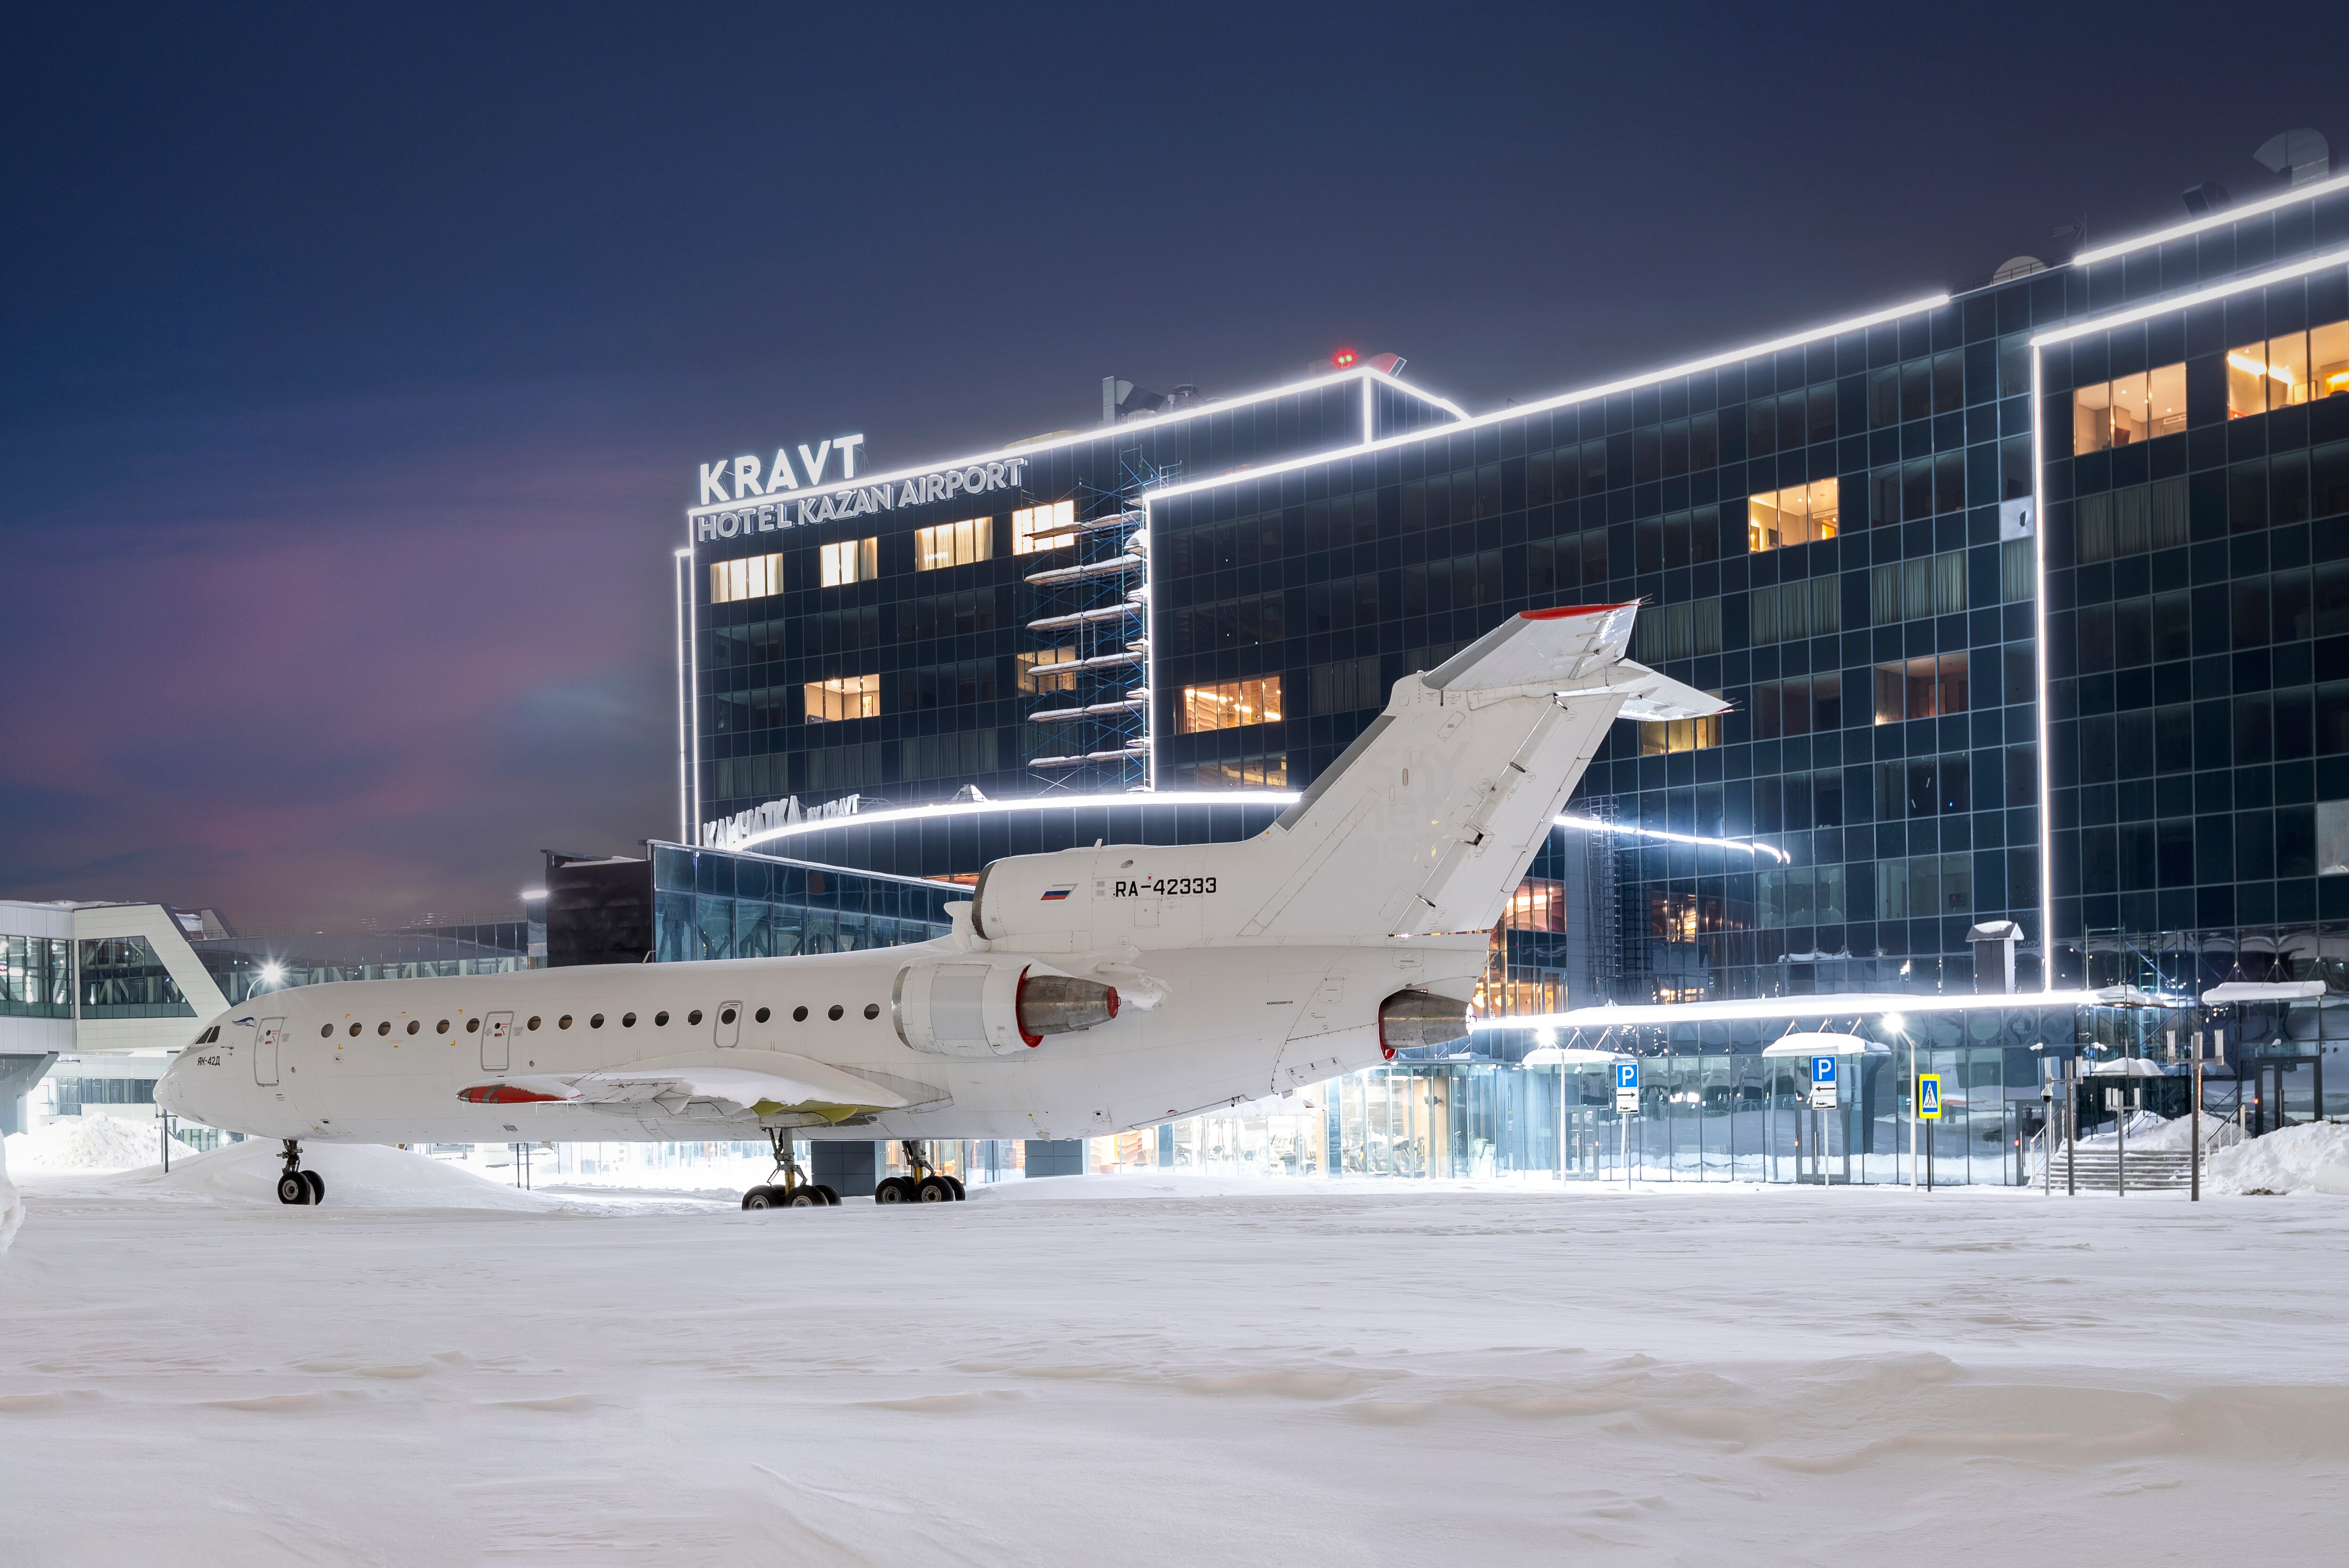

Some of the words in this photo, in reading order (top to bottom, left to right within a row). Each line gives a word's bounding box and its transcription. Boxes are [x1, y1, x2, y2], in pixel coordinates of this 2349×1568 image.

[700, 434, 863, 505] KRAVT
[698, 503, 793, 542] HOTEL
[798, 484, 891, 525] KAZAN
[898, 458, 1025, 507] AIRPORT
[823, 793, 860, 820] KRAVT
[1116, 877, 1216, 897] RA-42333
[197, 1056, 220, 1066] ЯК-42Д
[1818, 1059, 1832, 1080] P
[1622, 1066, 1635, 1086] P
